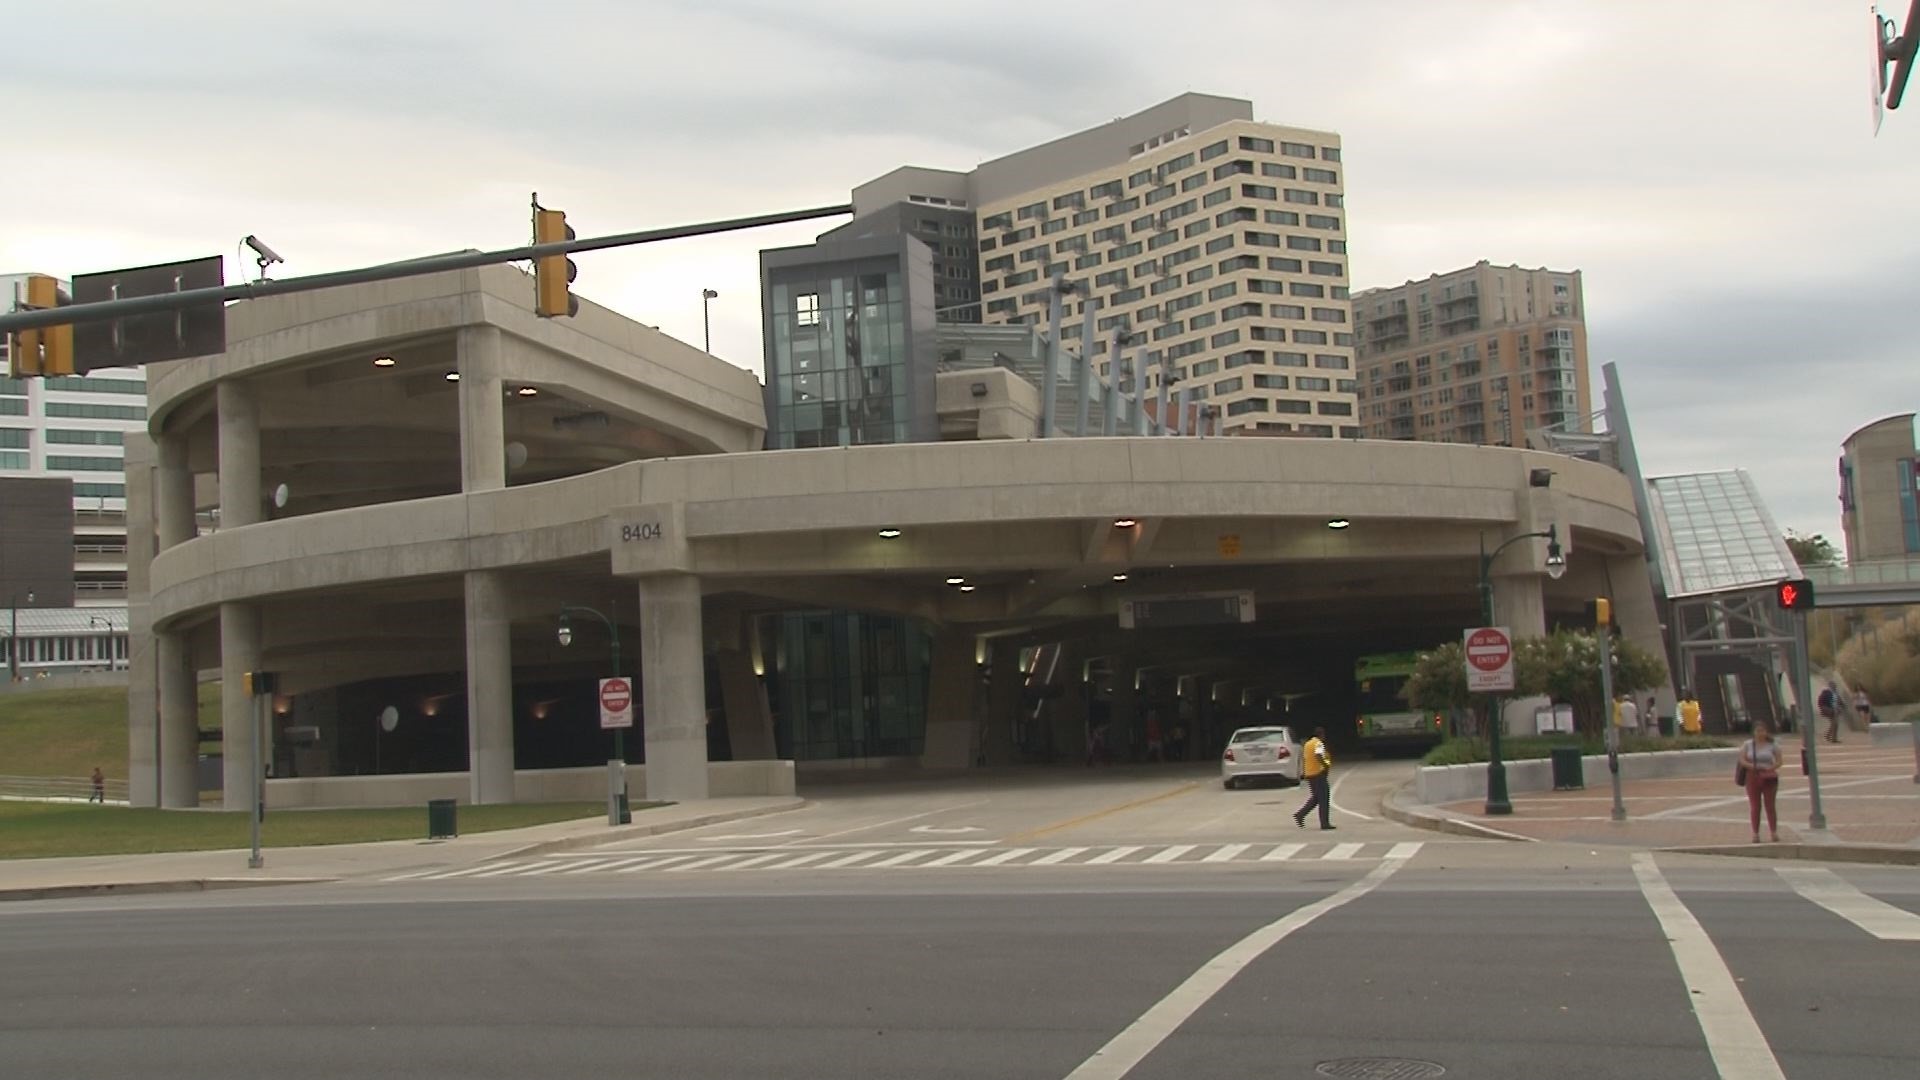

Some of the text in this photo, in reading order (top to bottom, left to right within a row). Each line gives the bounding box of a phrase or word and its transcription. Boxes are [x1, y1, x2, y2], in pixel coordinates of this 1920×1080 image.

[622, 523, 661, 541] 8404
[1473, 635, 1501, 645] DO NOT
[1476, 655, 1501, 665] ENTER
